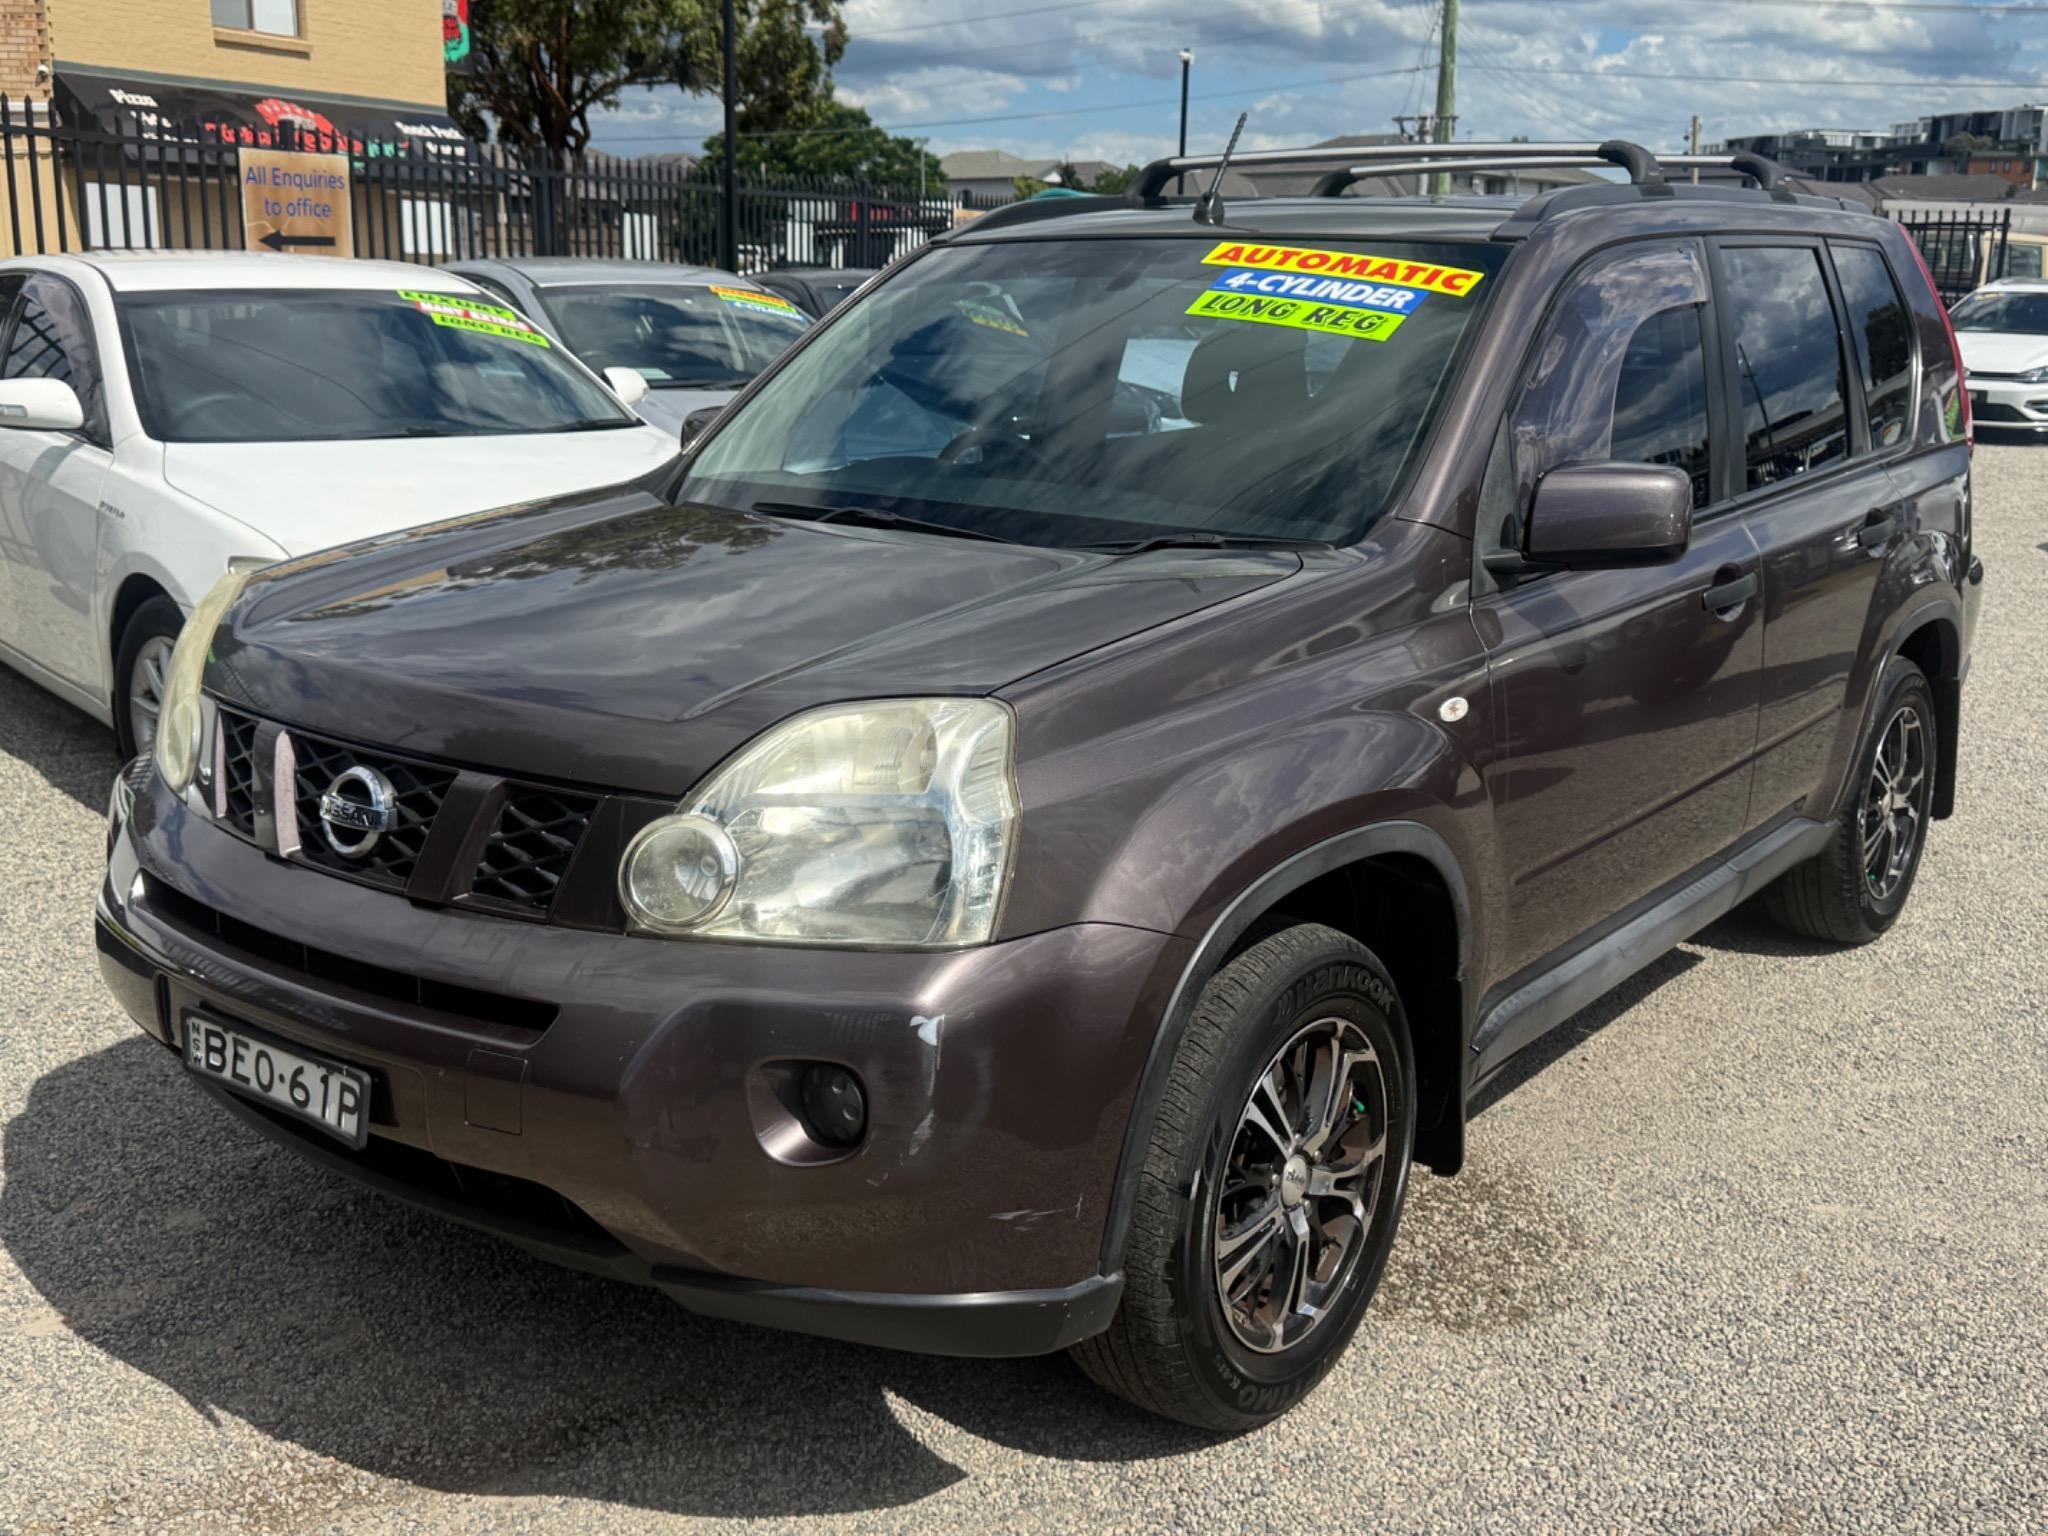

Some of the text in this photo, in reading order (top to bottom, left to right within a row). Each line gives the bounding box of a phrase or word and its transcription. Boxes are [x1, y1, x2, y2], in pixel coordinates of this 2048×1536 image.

[246, 165, 345, 190] All Enquiries
[264, 197, 332, 218] to office
[1212, 246, 1473, 291] AUTOMATIC
[403, 290, 504, 315] LUXURY
[1225, 272, 1415, 309] 4-CYLINDER
[439, 314, 543, 343] LONG REG
[1200, 294, 1387, 333] LONG REG
[322, 797, 379, 829] NISSAN
[191, 1021, 203, 1065] NSW
